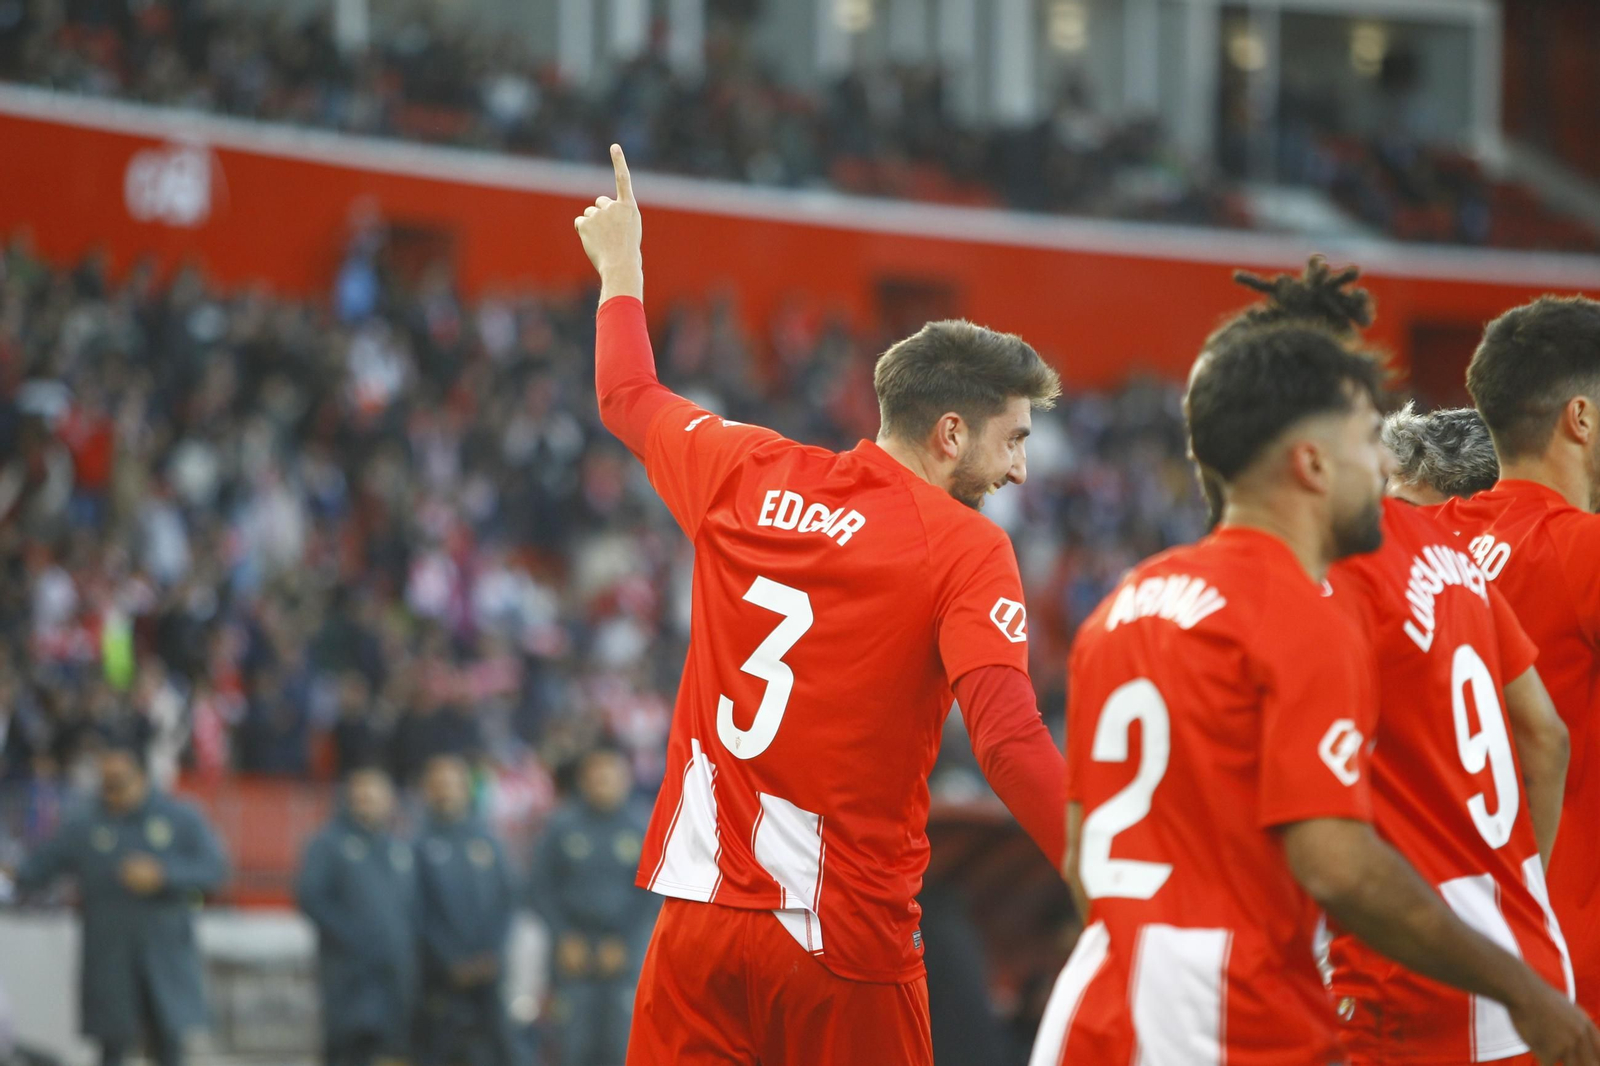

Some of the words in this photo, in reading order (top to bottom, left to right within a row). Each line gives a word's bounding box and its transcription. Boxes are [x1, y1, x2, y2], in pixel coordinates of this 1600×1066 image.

[757, 490, 866, 546] EDGAR
[716, 575, 814, 760] 3
[1451, 644, 1519, 850] 9
[1079, 677, 1173, 900] 2
